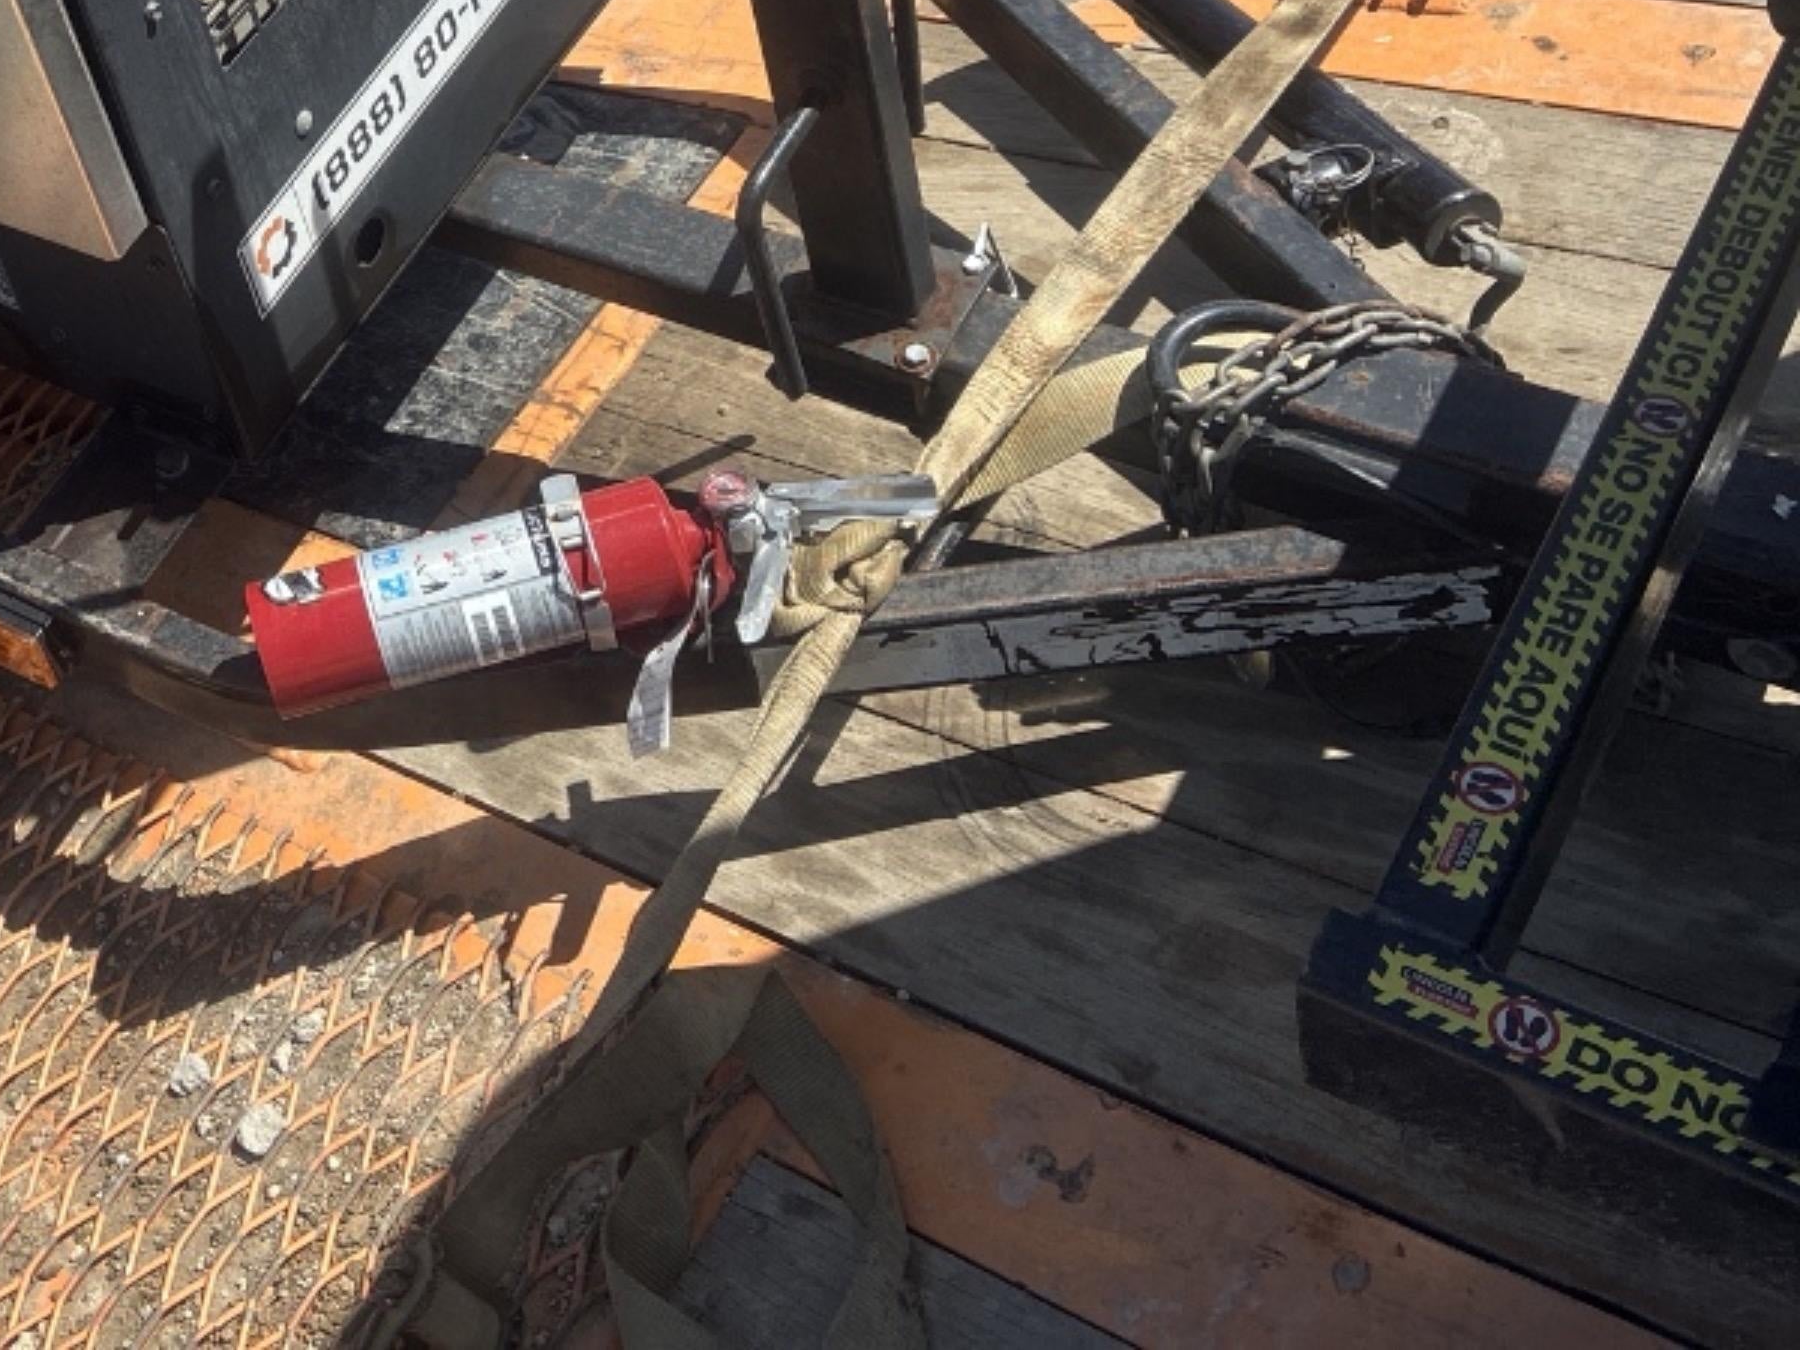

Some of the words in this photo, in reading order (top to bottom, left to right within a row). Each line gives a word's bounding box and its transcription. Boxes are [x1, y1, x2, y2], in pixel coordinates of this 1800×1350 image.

[311, 74, 408, 211] (888)
[1686, 203, 1772, 339] DEBOUT
[1661, 341, 1707, 391] ICI
[1612, 436, 1664, 494] NO
[1585, 497, 1635, 553] SE
[1535, 550, 1612, 659] PARE
[1566, 1036, 1659, 1095] DO
[1670, 1080, 1749, 1135] NO
